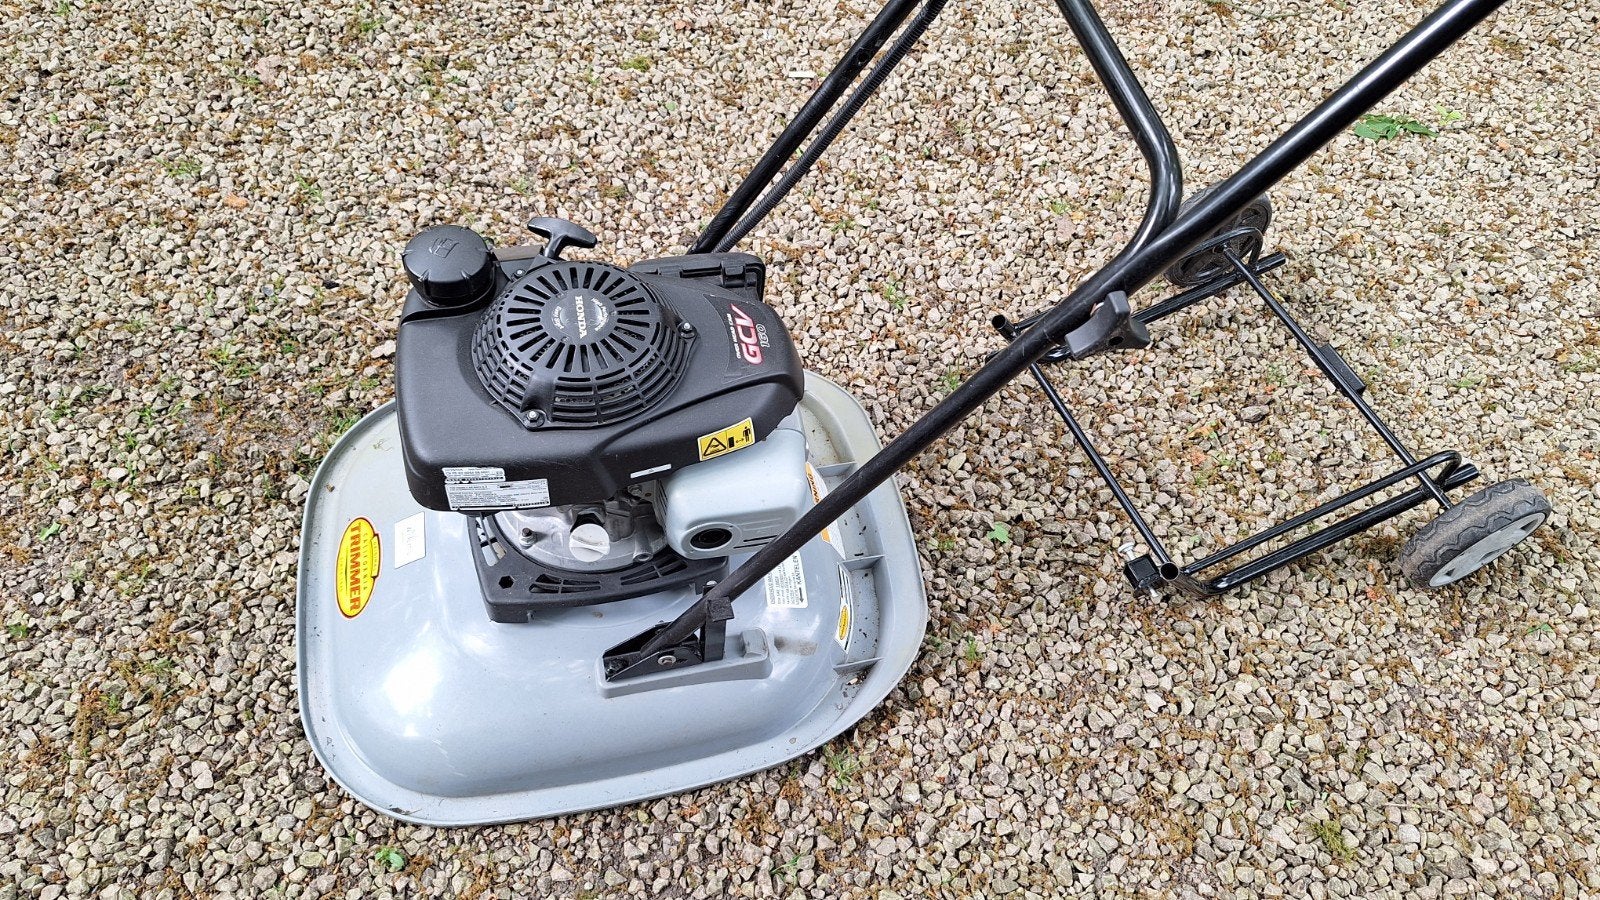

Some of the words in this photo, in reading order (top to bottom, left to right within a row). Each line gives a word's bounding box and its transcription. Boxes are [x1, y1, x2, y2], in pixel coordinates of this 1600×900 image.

[575, 295, 587, 339] HONDA
[730, 303, 764, 366] GCV
[755, 323, 771, 348] 160
[807, 473, 820, 503] RNING
[349, 522, 361, 611] TRIMMER
[792, 555, 802, 585] KANTELEN
